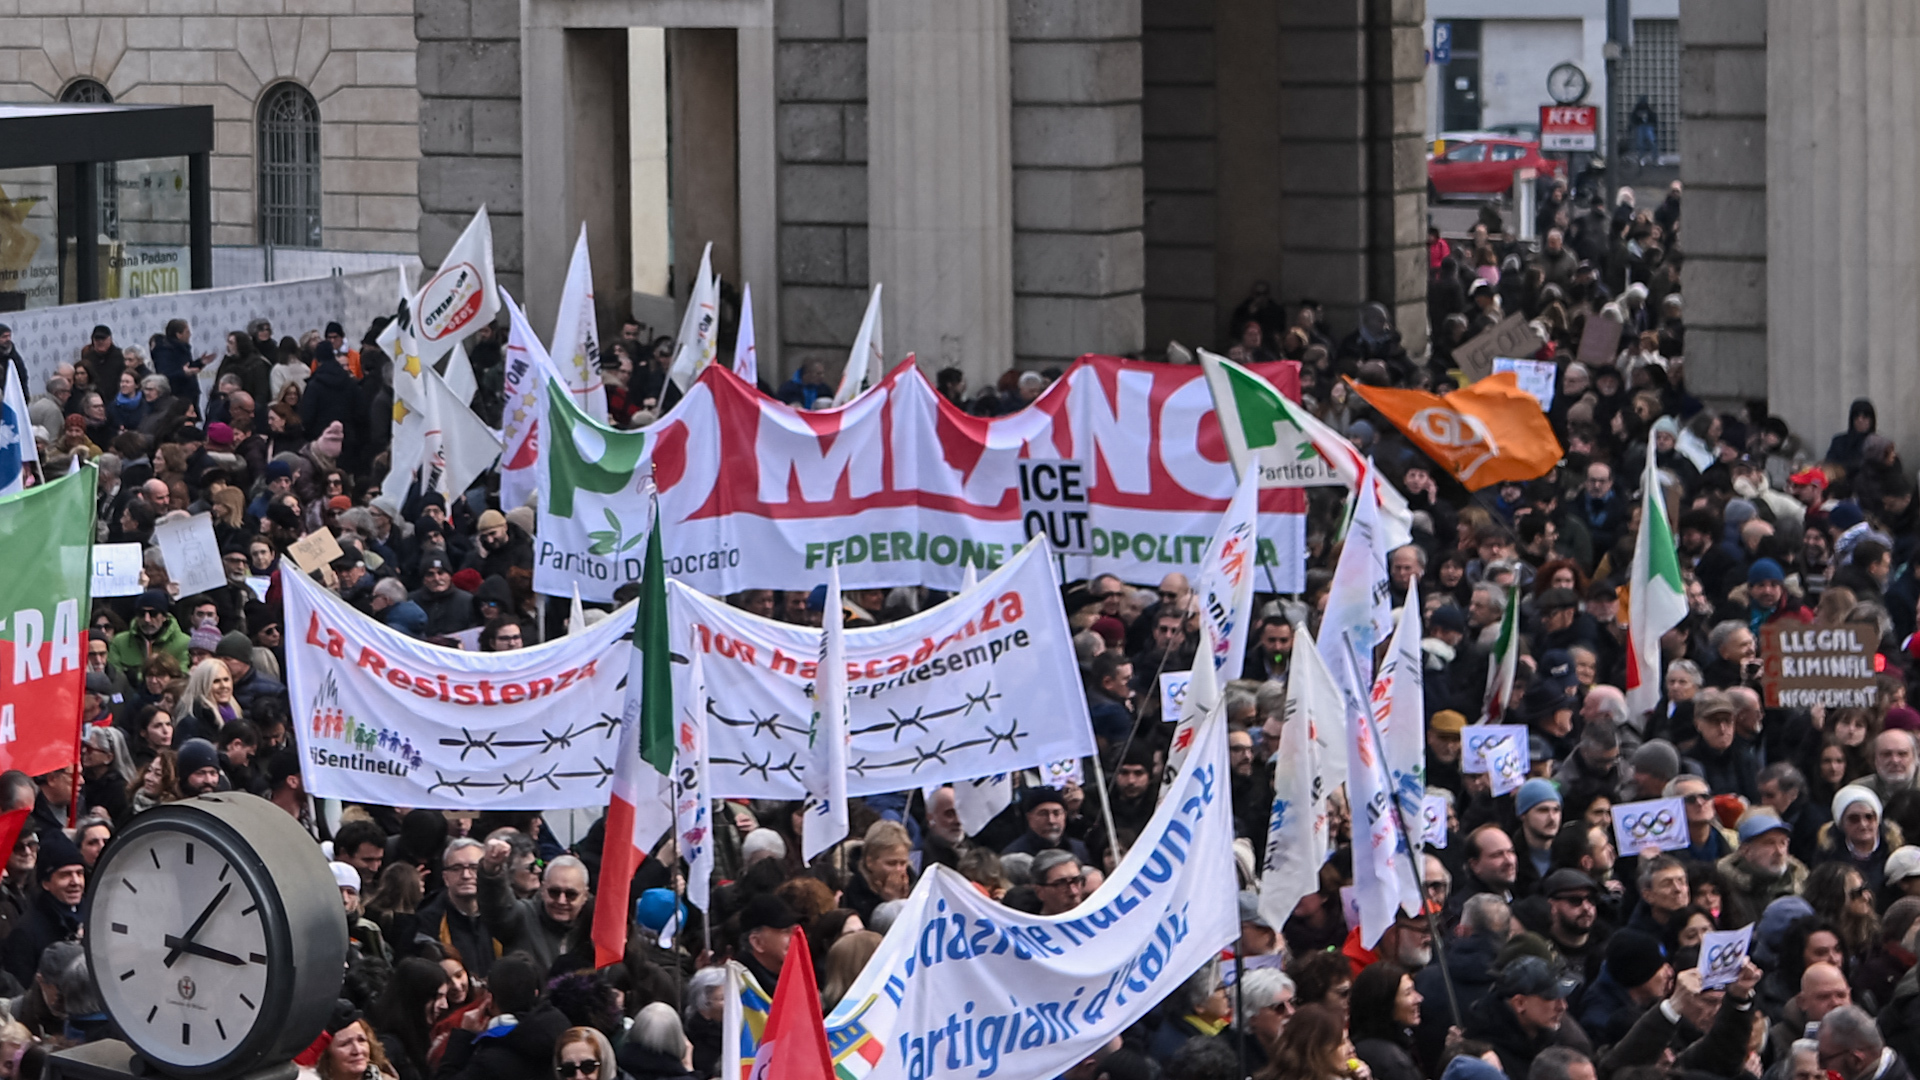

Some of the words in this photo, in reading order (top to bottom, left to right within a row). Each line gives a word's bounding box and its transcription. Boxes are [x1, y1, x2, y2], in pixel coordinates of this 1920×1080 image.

[1548, 108, 1589, 125] KFC
[109, 255, 139, 268] Grana
[141, 252, 178, 265] Padano
[130, 267, 179, 296] GUSTO
[1019, 464, 1084, 501] ICE
[1024, 510, 1088, 549] OUT
[306, 610, 346, 660] La
[357, 645, 600, 706] Resistenza
[696, 623, 757, 667] non
[770, 648, 817, 680] ha
